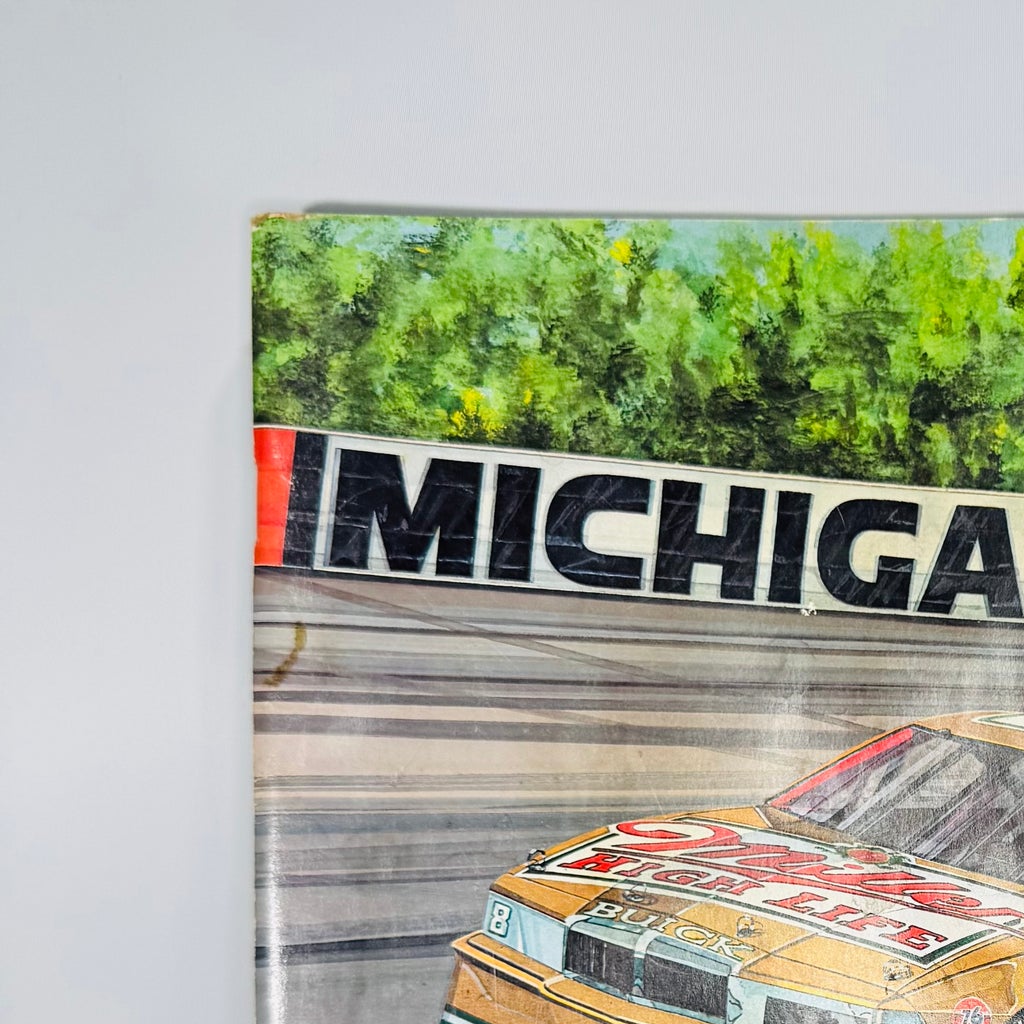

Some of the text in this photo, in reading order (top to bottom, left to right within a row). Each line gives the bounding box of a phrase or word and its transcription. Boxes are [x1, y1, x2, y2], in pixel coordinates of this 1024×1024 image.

[488, 900, 514, 938] 8
[559, 851, 949, 953] HIGH LIFE
[581, 900, 759, 960] BUICK
